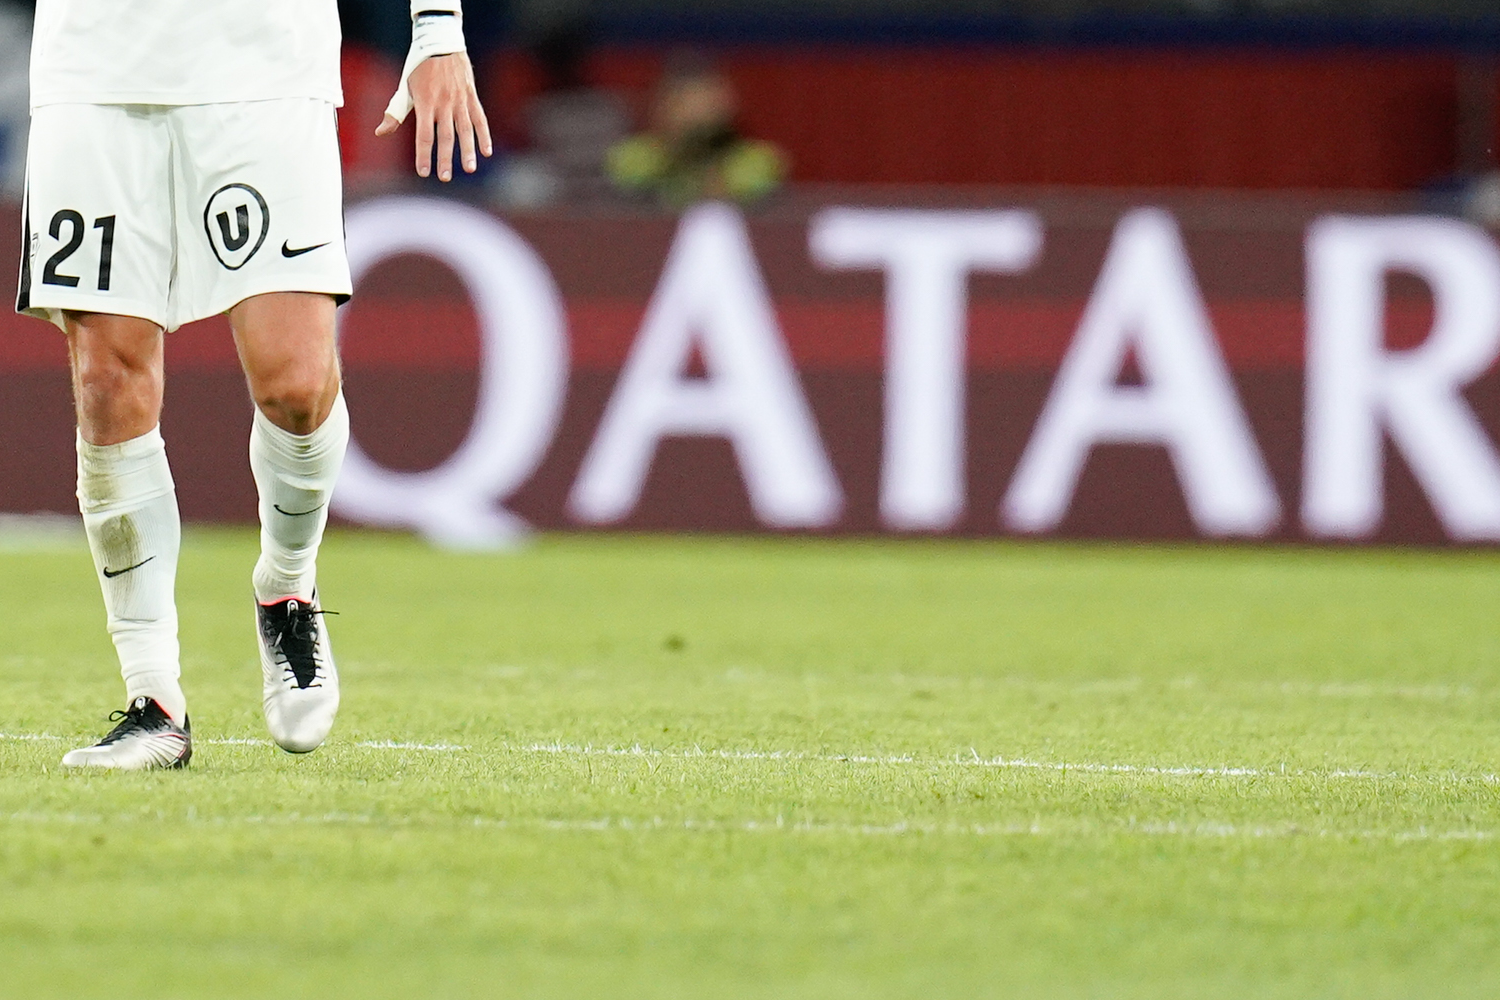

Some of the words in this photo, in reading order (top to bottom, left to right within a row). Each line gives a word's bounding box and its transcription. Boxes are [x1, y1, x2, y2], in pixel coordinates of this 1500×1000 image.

[42, 209, 116, 291] 21
[215, 203, 250, 252] U
[338, 197, 1500, 550] QATAR
